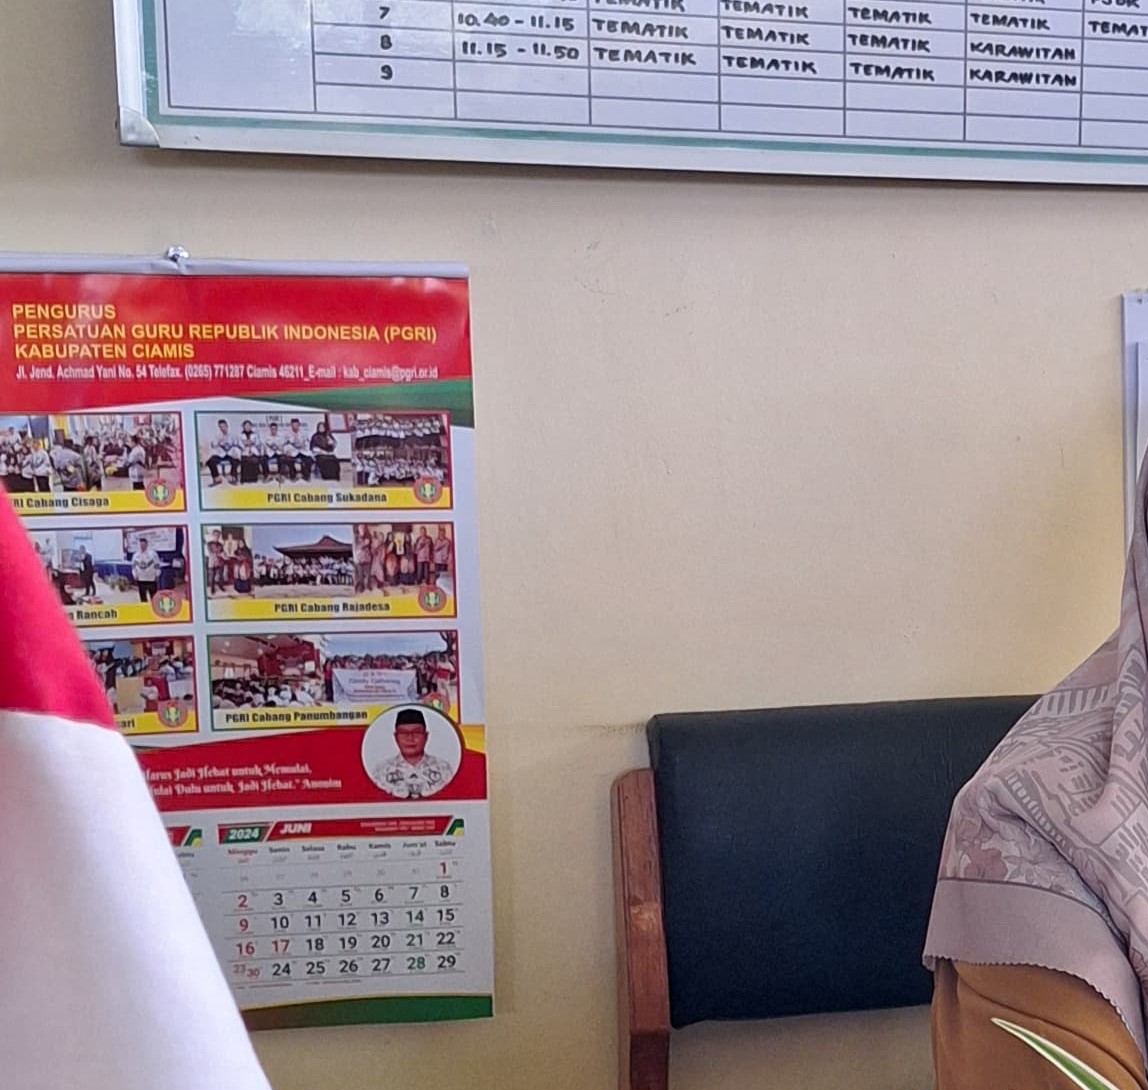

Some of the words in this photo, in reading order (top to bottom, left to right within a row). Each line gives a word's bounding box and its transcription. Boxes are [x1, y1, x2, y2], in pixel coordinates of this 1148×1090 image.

[721, 0, 809, 19] TEMATIK
[848, 7, 932, 25] TEMATIK
[970, 13, 1050, 31] TEMATIK
[378, 7, 389, 20] 7
[531, 15, 575, 31] 11.15
[592, 18, 689, 39] TEMATIK
[721, 25, 810, 46] TEMATIK
[847, 33, 931, 53] TEMATIK
[969, 42, 1076, 60] KARAWITAN
[380, 64, 393, 81] 9
[461, 41, 507, 58] 11.15
[533, 43, 580, 60] 11.50
[593, 47, 697, 66] TEMATIK
[722, 55, 818, 75] TEMATIK
[849, 62, 935, 82] TEMATIK
[969, 69, 1077, 87] KARAWITAN
[12, 303, 116, 320] PENGURUS
[14, 323, 125, 339] PERSATUAN
[131, 324, 184, 339] GURU
[189, 325, 277, 340] REPUBLIK
[284, 325, 379, 341] INDONESIA
[384, 326, 437, 344] (PGRI)
[15, 343, 126, 359] KABUPATEN
[132, 343, 194, 359] CIAMIS
[57, 365, 94, 379] Achmad
[96, 365, 116, 379] Yani
[118, 365, 133, 379] No.
[136, 364, 147, 378] 54
[247, 365, 277, 379] Ciamis
[27, 497, 69, 509] Cabang
[71, 496, 109, 508] Cisaga
[267, 493, 291, 503] PGRI
[294, 492, 333, 504] Cabang
[336, 492, 387, 502] Sukadana
[76, 609, 117, 620] Rancah
[274, 603, 298, 613] PGRI
[301, 602, 340, 614] Cabang
[342, 601, 390, 613] Rajadesa
[226, 713, 249, 723] PGRI
[252, 711, 291, 723] Cabang
[294, 710, 367, 722] Panumbangan
[228, 827, 260, 840] 2024
[280, 823, 312, 834] JUNI
[440, 861, 447, 875] 1
[238, 895, 248, 908] 2
[274, 893, 284, 906] 3
[308, 891, 318, 904] 4
[341, 889, 351, 902] 5
[374, 888, 384, 901] 6
[409, 887, 419, 900] 7
[440, 885, 449, 898] 8
[239, 919, 249, 932] 9
[271, 916, 289, 929] 10
[305, 915, 321, 928] 11
[338, 913, 356, 926] 12
[371, 912, 389, 925] 13
[406, 910, 424, 923] 14
[437, 908, 455, 922] 15
[236, 942, 255, 955] 16
[272, 939, 290, 953] 17
[306, 938, 324, 951] 18
[339, 936, 357, 949] 19
[371, 935, 390, 948] 20
[406, 933, 423, 946] 21
[436, 931, 455, 945] 22
[272, 963, 291, 976] 24
[306, 961, 325, 974] 25
[339, 960, 358, 972] 26
[371, 958, 390, 971] 27
[406, 956, 425, 969] 28
[437, 955, 456, 968] 29
